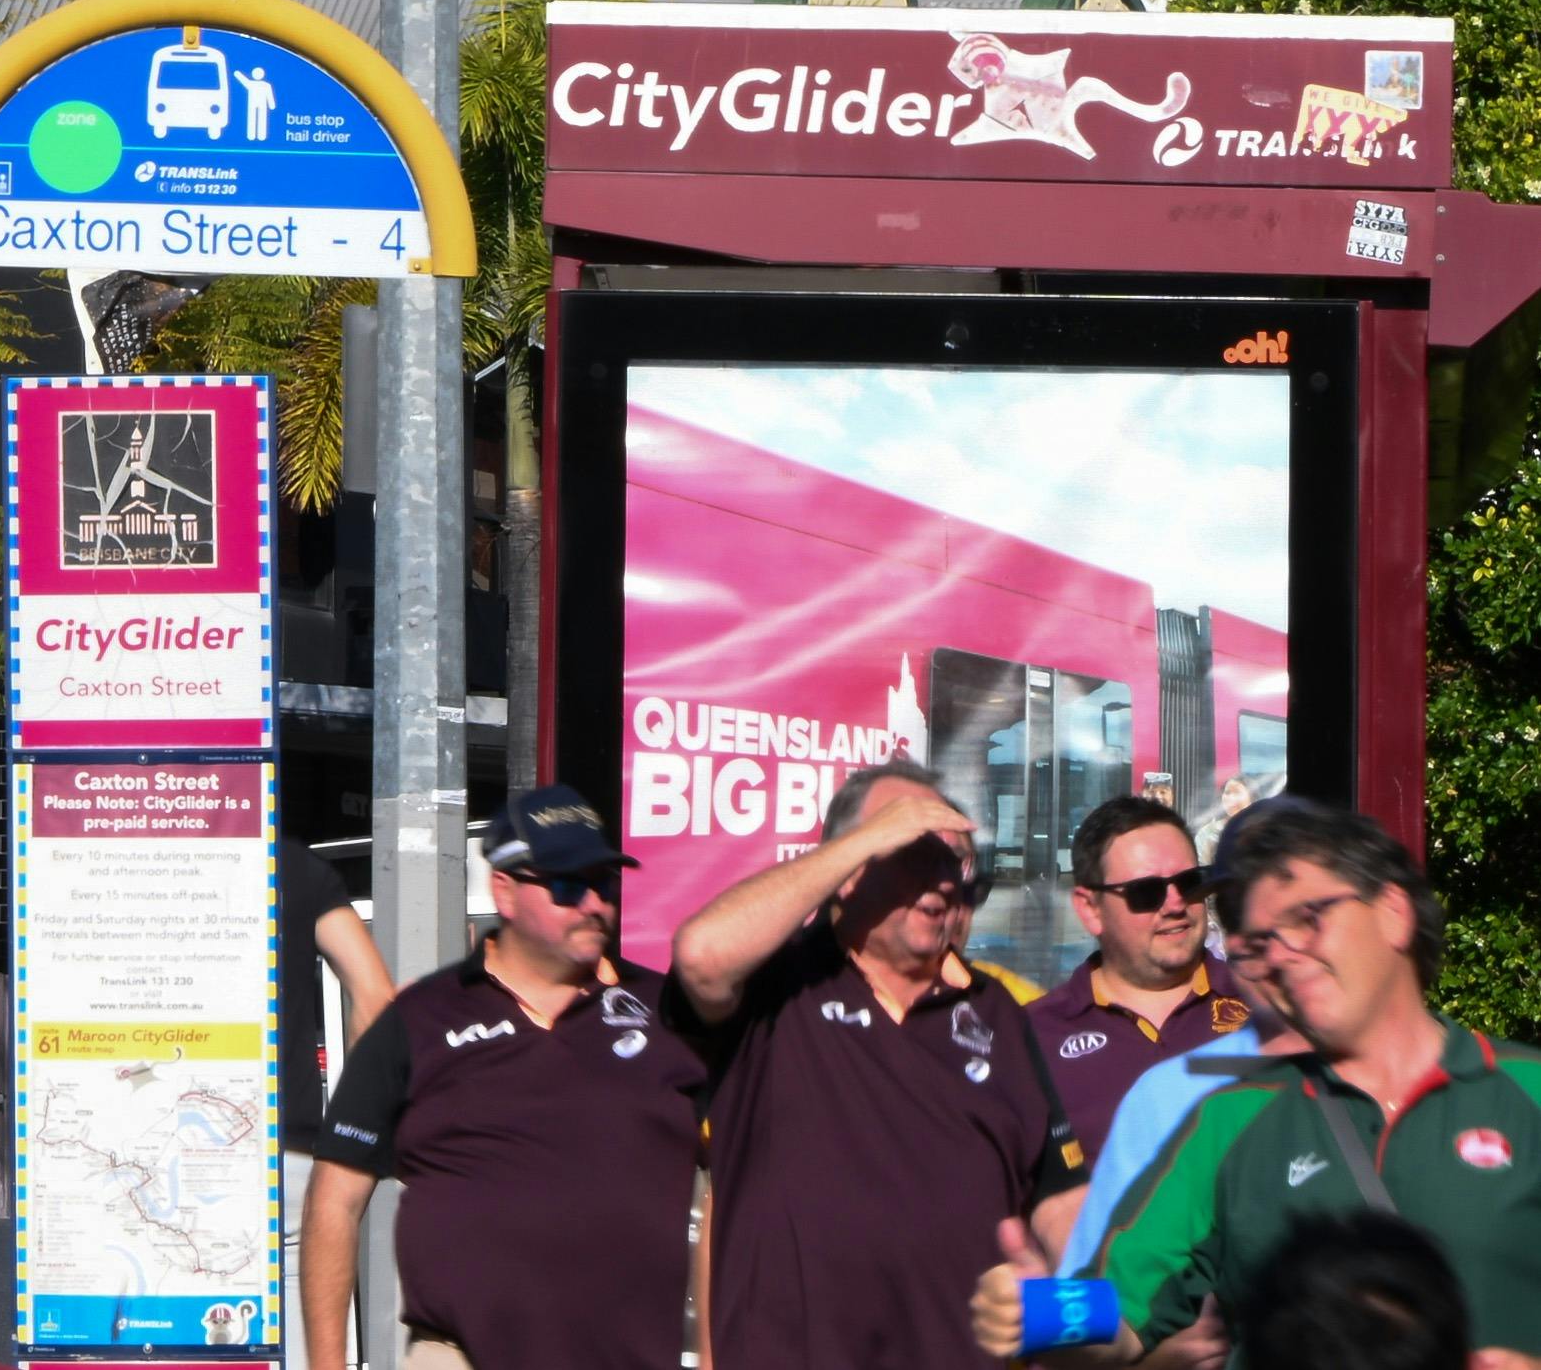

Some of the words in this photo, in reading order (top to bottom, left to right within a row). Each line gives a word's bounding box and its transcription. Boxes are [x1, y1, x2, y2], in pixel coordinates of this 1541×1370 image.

[552, 60, 976, 152] CityGlider
[56, 112, 97, 126] zone
[286, 111, 314, 127] bus
[317, 113, 344, 130] stop
[285, 129, 308, 144] hail
[310, 129, 350, 145] driver
[159, 165, 239, 181] TRANSLink
[170, 182, 192, 194] info
[193, 183, 208, 195] 13
[208, 183, 221, 195] 12
[221, 184, 237, 196] 30
[1355, 200, 1405, 222] SYFA
[162, 207, 298, 259] Street
[380, 218, 406, 261] 4
[79, 546, 157, 563] BRISBANE
[160, 546, 197, 561] CITY
[35, 616, 244, 662] CityGlider
[59, 677, 142, 698] Caxton
[151, 676, 222, 697] Street
[633, 697, 911, 764] QUEENSLAND'S
[74, 771, 148, 791] Caxton
[154, 771, 220, 791] Street
[630, 752, 767, 837] BIG
[43, 795, 92, 810] Please
[96, 795, 139, 810] Note:
[143, 795, 220, 814] CityGlider
[225, 796, 236, 810] is
[240, 799, 251, 810] a
[84, 815, 147, 832] pre-paid
[151, 816, 209, 830] service.
[52, 851, 84, 863] Every
[88, 851, 100, 861] 10
[104, 851, 150, 862] minutes
[153, 851, 190, 865] during
[193, 851, 241, 865] morning
[88, 866, 110, 877] and
[113, 866, 169, 877] afternoon
[173, 866, 203, 879] peak.
[71, 890, 101, 903] Every
[106, 890, 119, 900] 15
[123, 890, 168, 900] minutes
[171, 889, 222, 903] off-peak.
[34, 913, 69, 927] Friday
[71, 913, 92, 924] and
[96, 913, 146, 927] Saturday
[149, 913, 185, 927] nights
[189, 914, 199, 925] at
[203, 914, 217, 925] 30
[221, 913, 259, 925] minute
[41, 929, 88, 940] intervals
[92, 929, 141, 940] between
[145, 929, 196, 943] midnight
[200, 929, 221, 940] and
[224, 930, 250, 940] 5am.
[52, 953, 67, 962] For
[71, 952, 104, 962] further
[107, 953, 142, 962] service
[160, 953, 182, 965] stop
[185, 952, 242, 962] information
[100, 977, 147, 986] TransLink
[152, 977, 170, 986] 131
[174, 977, 193, 986] 230
[144, 989, 162, 998] visit
[90, 1001, 203, 1011] www.translink.com.au
[38, 1036, 60, 1054] 61
[67, 1029, 126, 1043] Maroon
[132, 1029, 210, 1045] CityGlider
[1066, 1033, 1100, 1054] KIA
[67, 1045, 93, 1054] route
[96, 1046, 114, 1056] map
